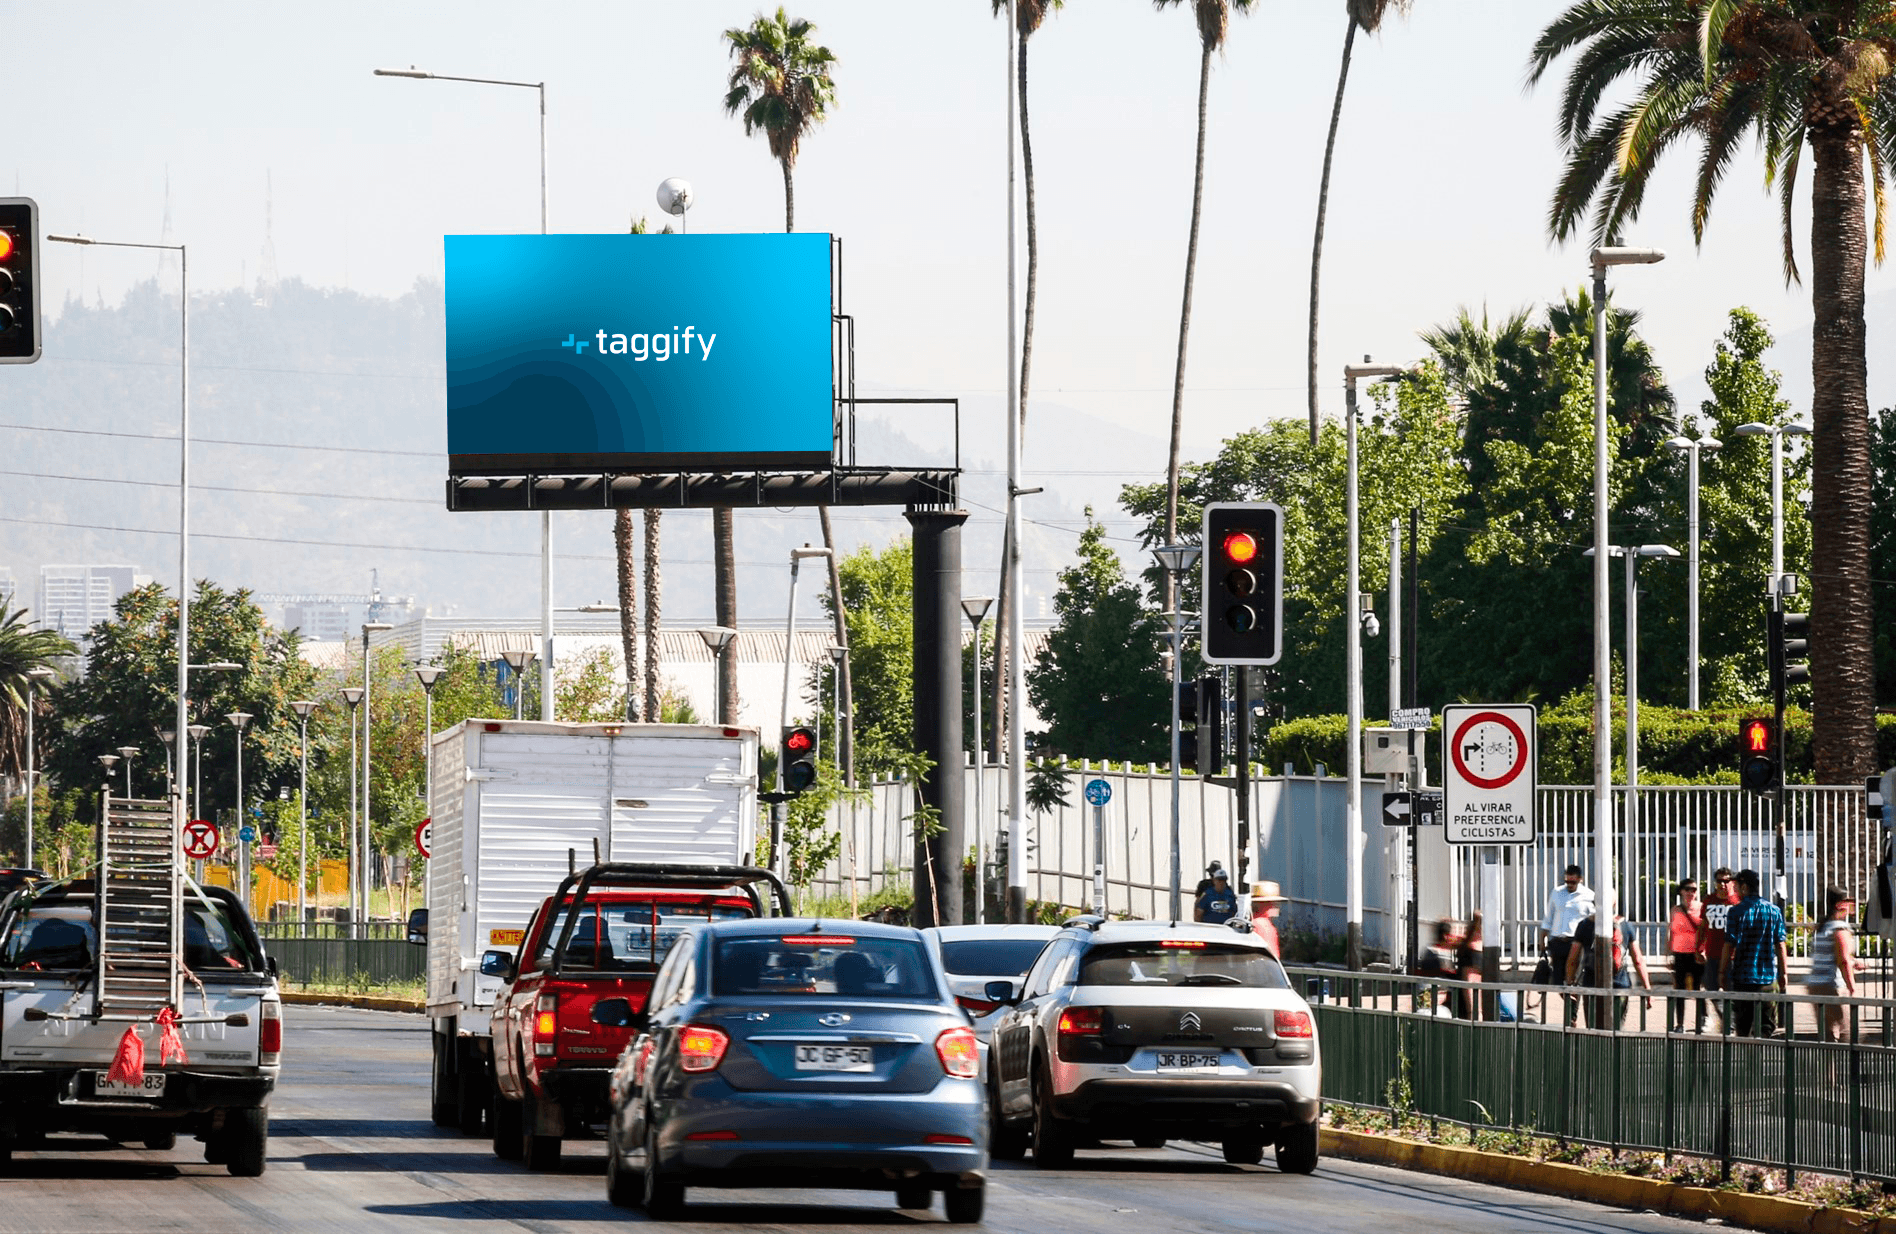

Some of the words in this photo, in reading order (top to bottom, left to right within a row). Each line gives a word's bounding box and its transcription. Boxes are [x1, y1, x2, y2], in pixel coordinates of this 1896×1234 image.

[596, 325, 717, 361] taggify
[1391, 707, 1431, 717] COMPRO
[1464, 803, 1478, 812] AL
[1480, 803, 1512, 812] VIRAR
[1454, 815, 1526, 825] PREFERENCIA
[1461, 827, 1516, 837] CICLISTAS
